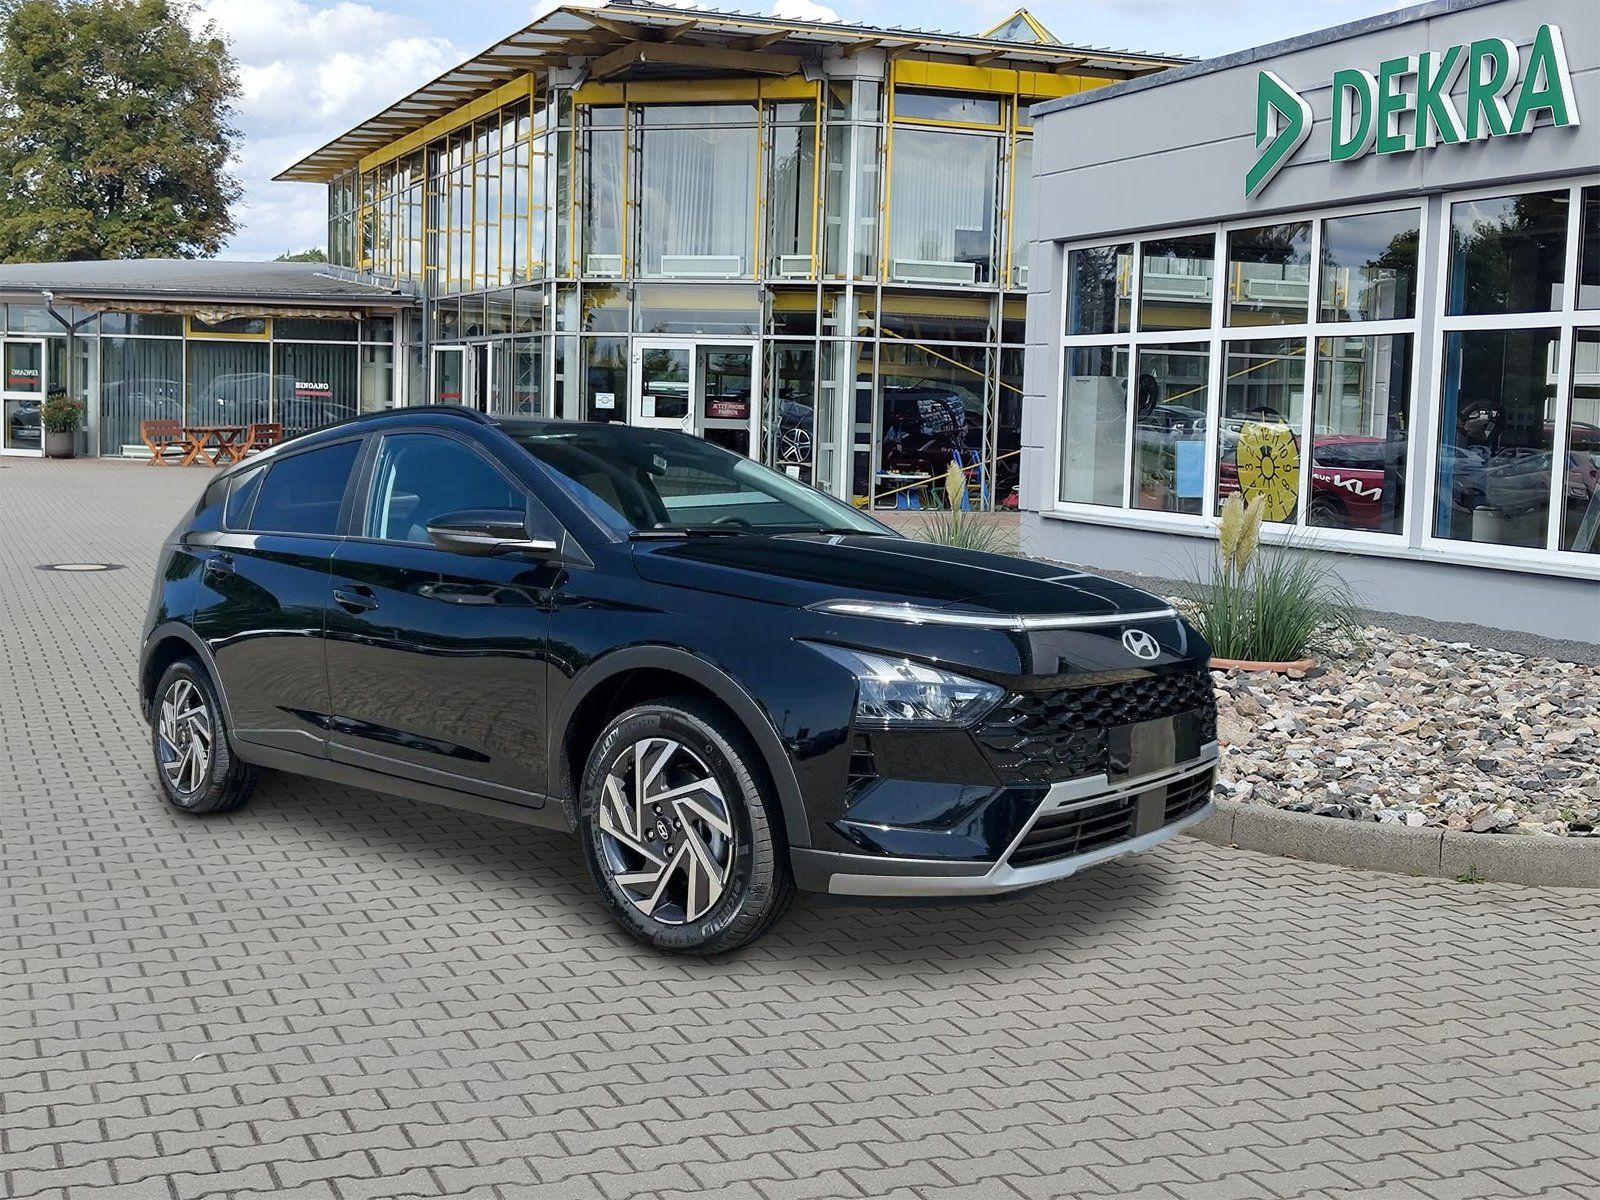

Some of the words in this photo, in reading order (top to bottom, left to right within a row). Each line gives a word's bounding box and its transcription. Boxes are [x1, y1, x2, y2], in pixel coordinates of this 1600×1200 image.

[1330, 23, 1580, 163] DEKRA
[295, 382, 329, 390] EINGANG
[1260, 427, 1269, 441] 12
[1244, 463, 1254, 471] 3
